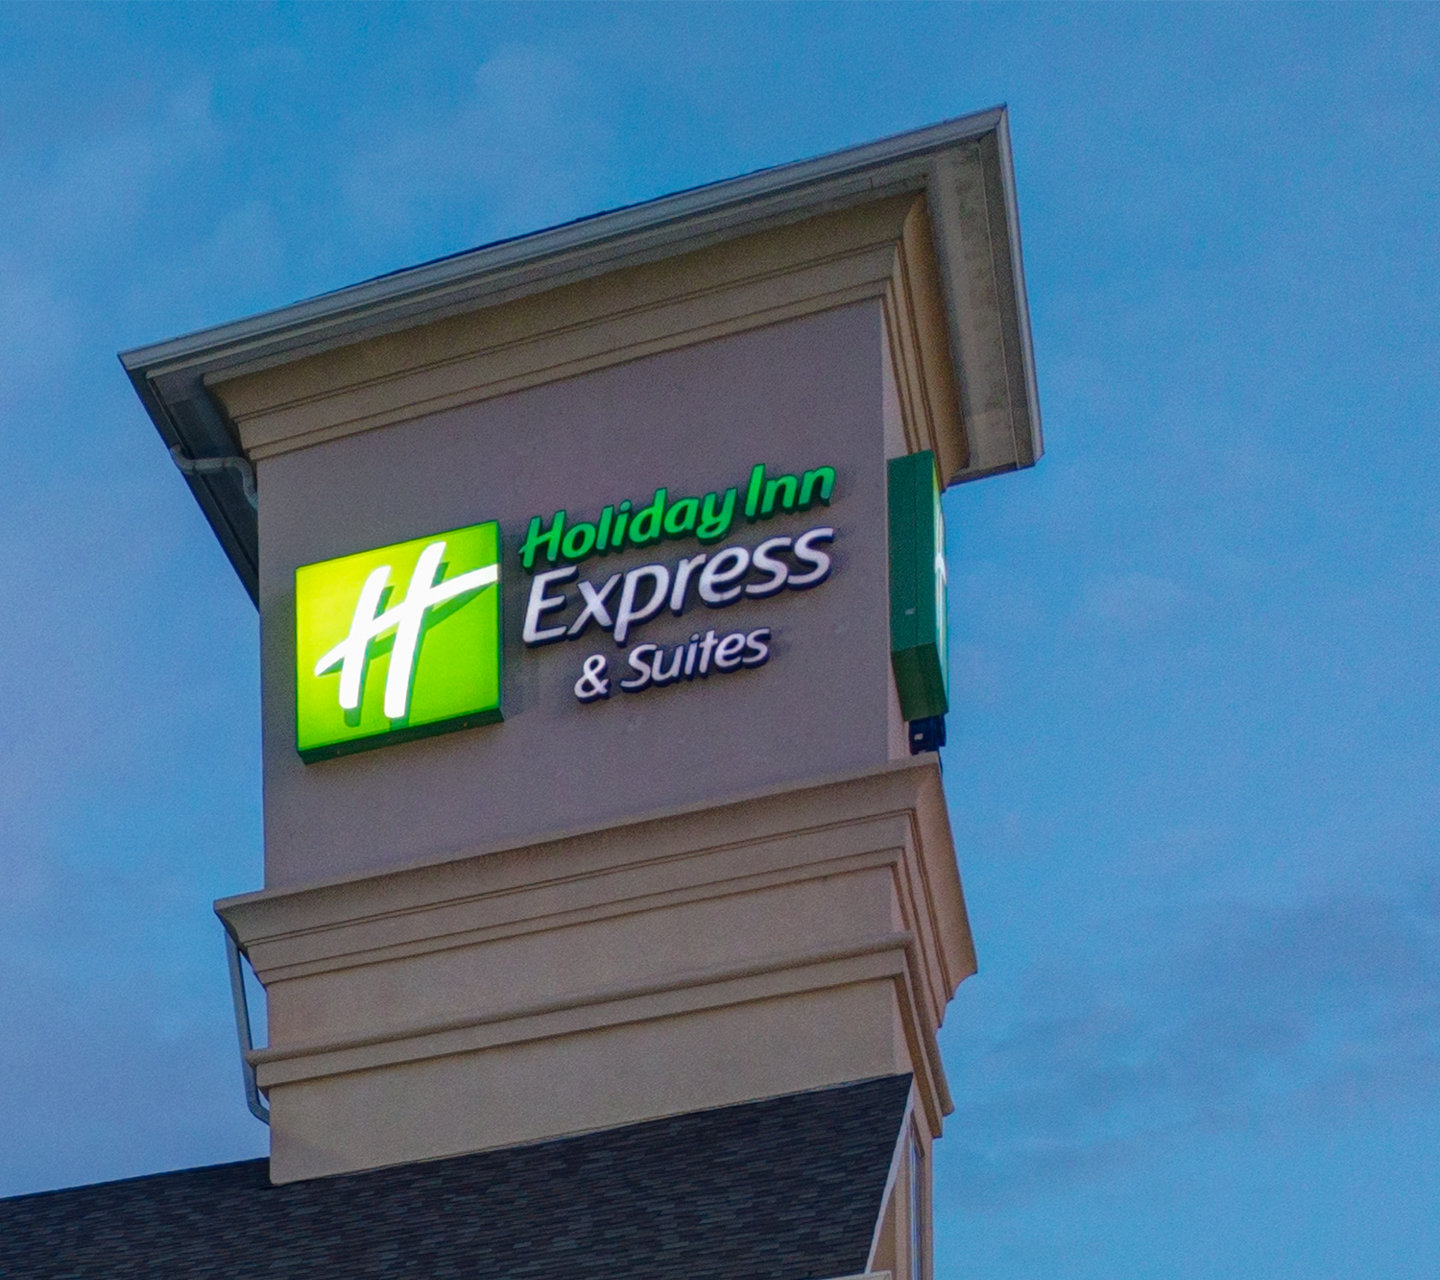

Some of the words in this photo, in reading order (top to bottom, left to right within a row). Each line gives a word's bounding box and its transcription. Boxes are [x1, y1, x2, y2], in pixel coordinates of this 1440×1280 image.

[519, 487, 738, 570] Holiday
[744, 462, 837, 520] Inn
[522, 526, 835, 647] Express
[573, 653, 610, 703] &
[620, 626, 771, 694] Suites
